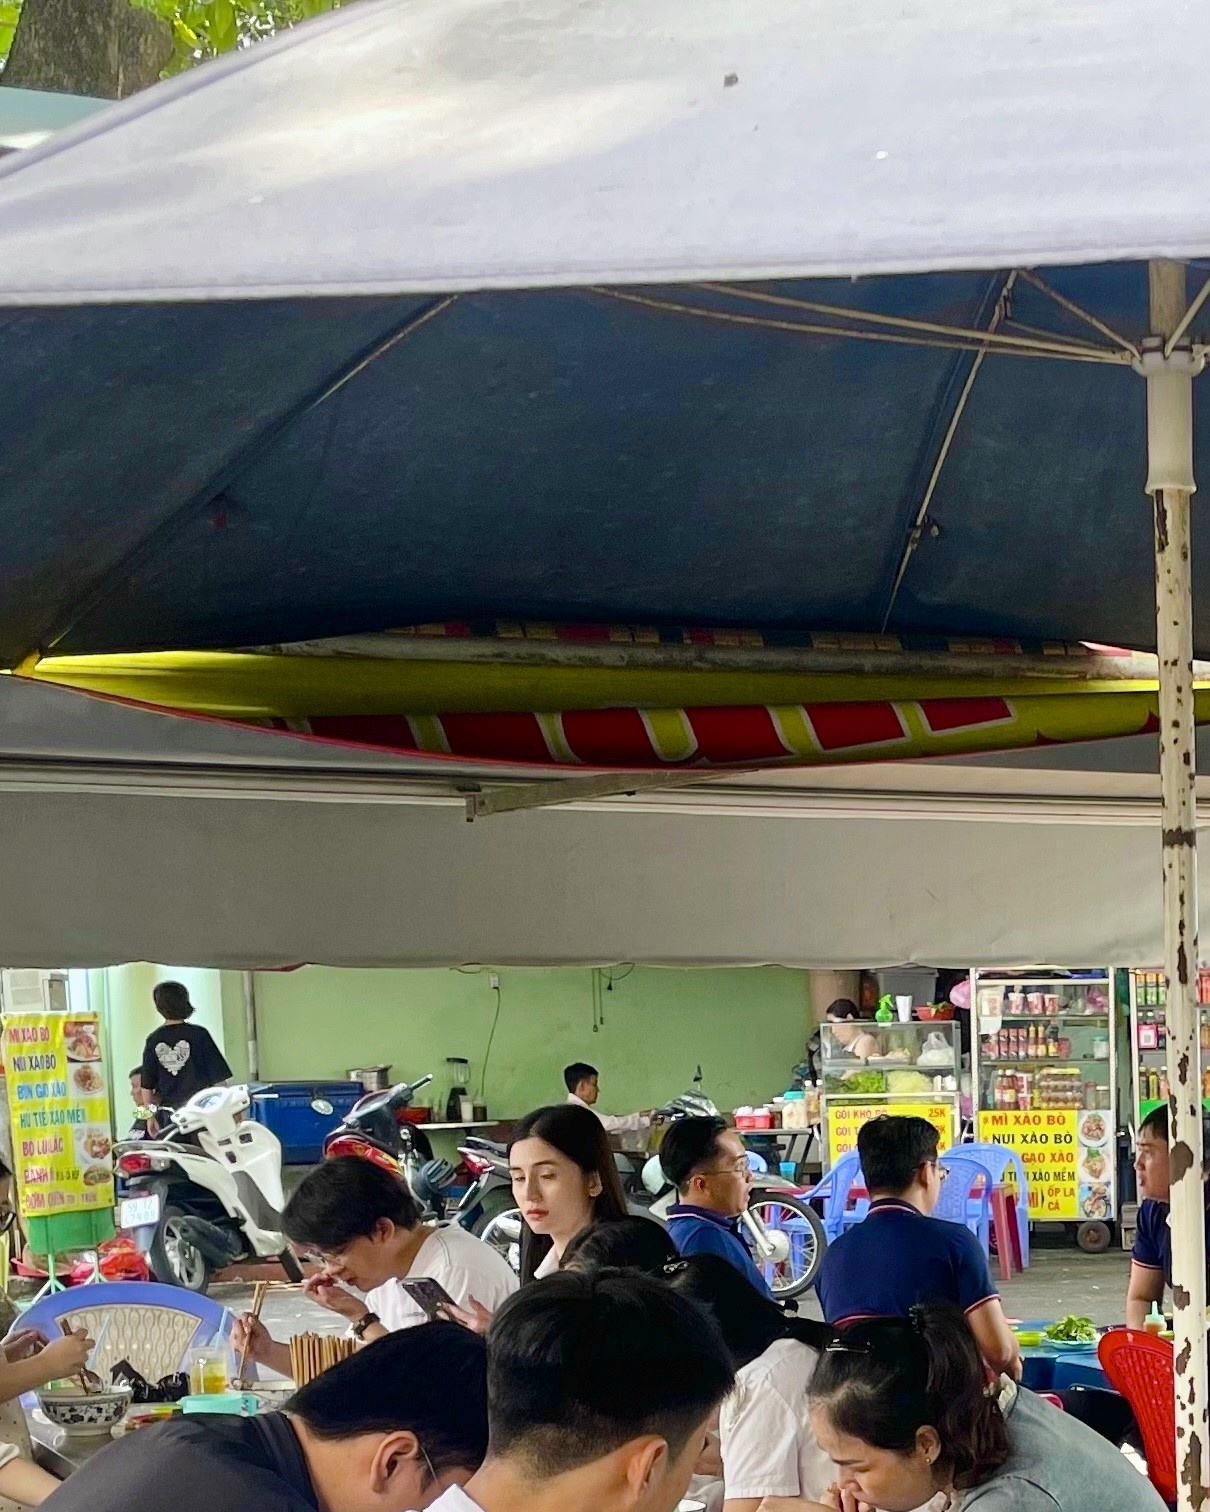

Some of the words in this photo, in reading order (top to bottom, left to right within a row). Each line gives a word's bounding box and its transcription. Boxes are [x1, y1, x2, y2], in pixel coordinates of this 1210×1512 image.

[992, 1113, 1008, 1126] MÌ
[1013, 1112, 1041, 1126] XÀO
[1047, 1112, 1066, 1126] BÒ
[992, 1133, 1015, 1145] NUI
[1020, 1131, 1048, 1145] XÀO
[1053, 1131, 1073, 1145] BÒ
[1050, 1150, 1074, 1164] XÀO
[1032, 1168, 1050, 1182] XÀO
[1063, 1187, 1076, 1198] LA
[1047, 1200, 1061, 1212] CÁ
